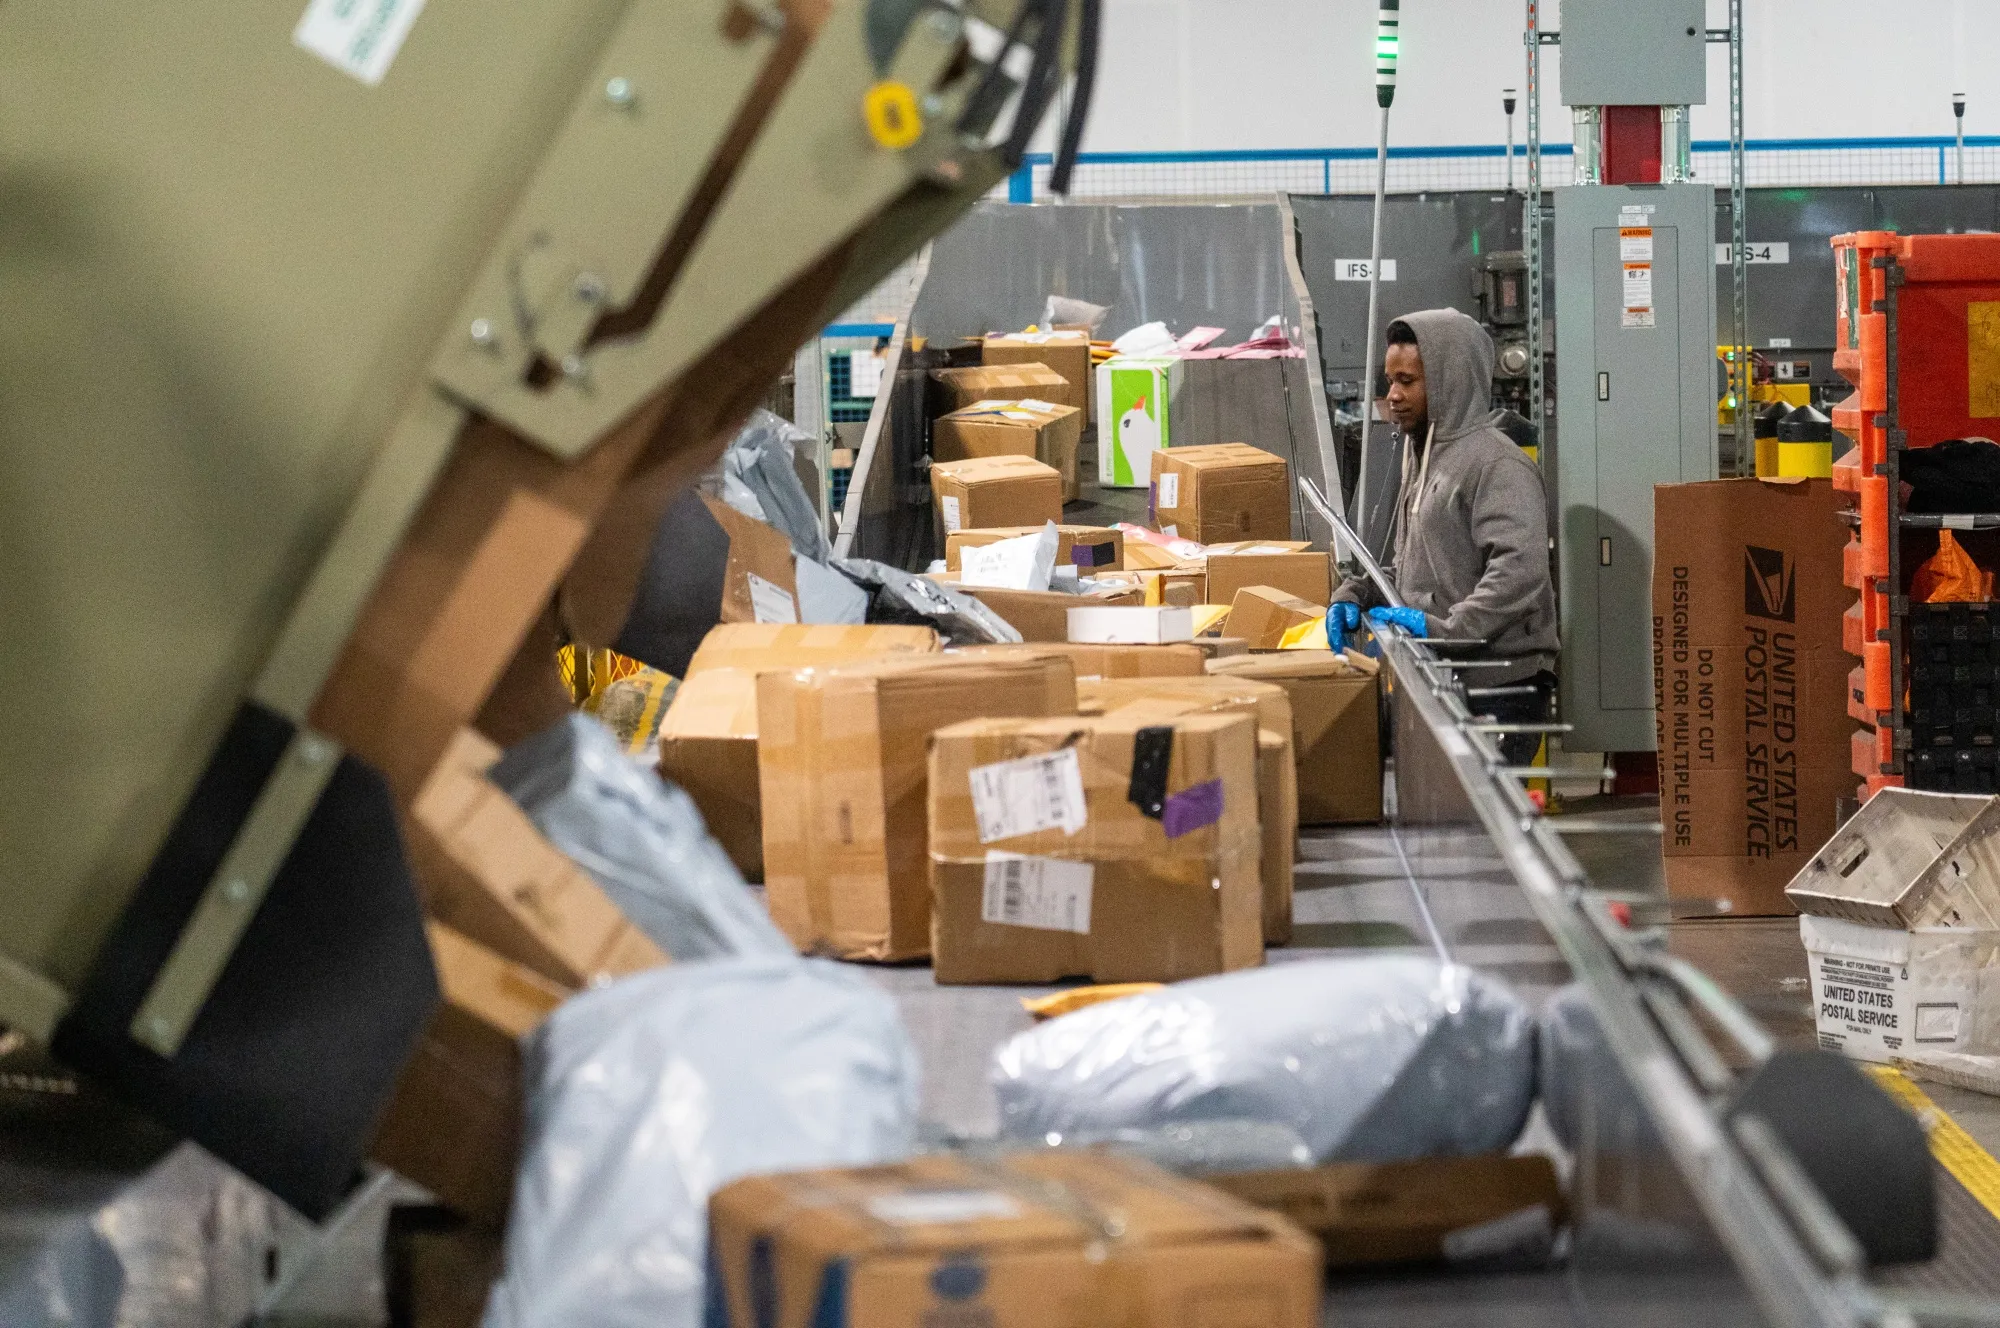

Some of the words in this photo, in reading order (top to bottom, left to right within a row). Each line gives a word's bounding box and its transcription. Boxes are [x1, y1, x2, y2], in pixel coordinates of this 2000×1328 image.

[1726, 247, 1771, 261] IS-4
[1673, 566, 1688, 663] DESIGNED
[1698, 649, 1713, 677] DO
[1745, 625, 1768, 734] POSTAL
[1673, 669, 1689, 706] FOR
[1698, 682, 1714, 721] NOT
[1772, 632, 1796, 744] UNITED
[1673, 713, 1690, 805] MULTIPLE
[1698, 727, 1714, 762] CUT
[1745, 741, 1770, 860] SERVICE
[1773, 747, 1798, 851] STATES
[1675, 810, 1691, 846] USE
[1824, 958, 1843, 967] WARNING
[1865, 964, 1880, 972] PRIVATE
[1824, 985, 1855, 1002] UNITED
[1858, 991, 1893, 1008] STATES
[1822, 1003, 1855, 1022] POSTAL
[1858, 1009, 1898, 1028] SERVICE
